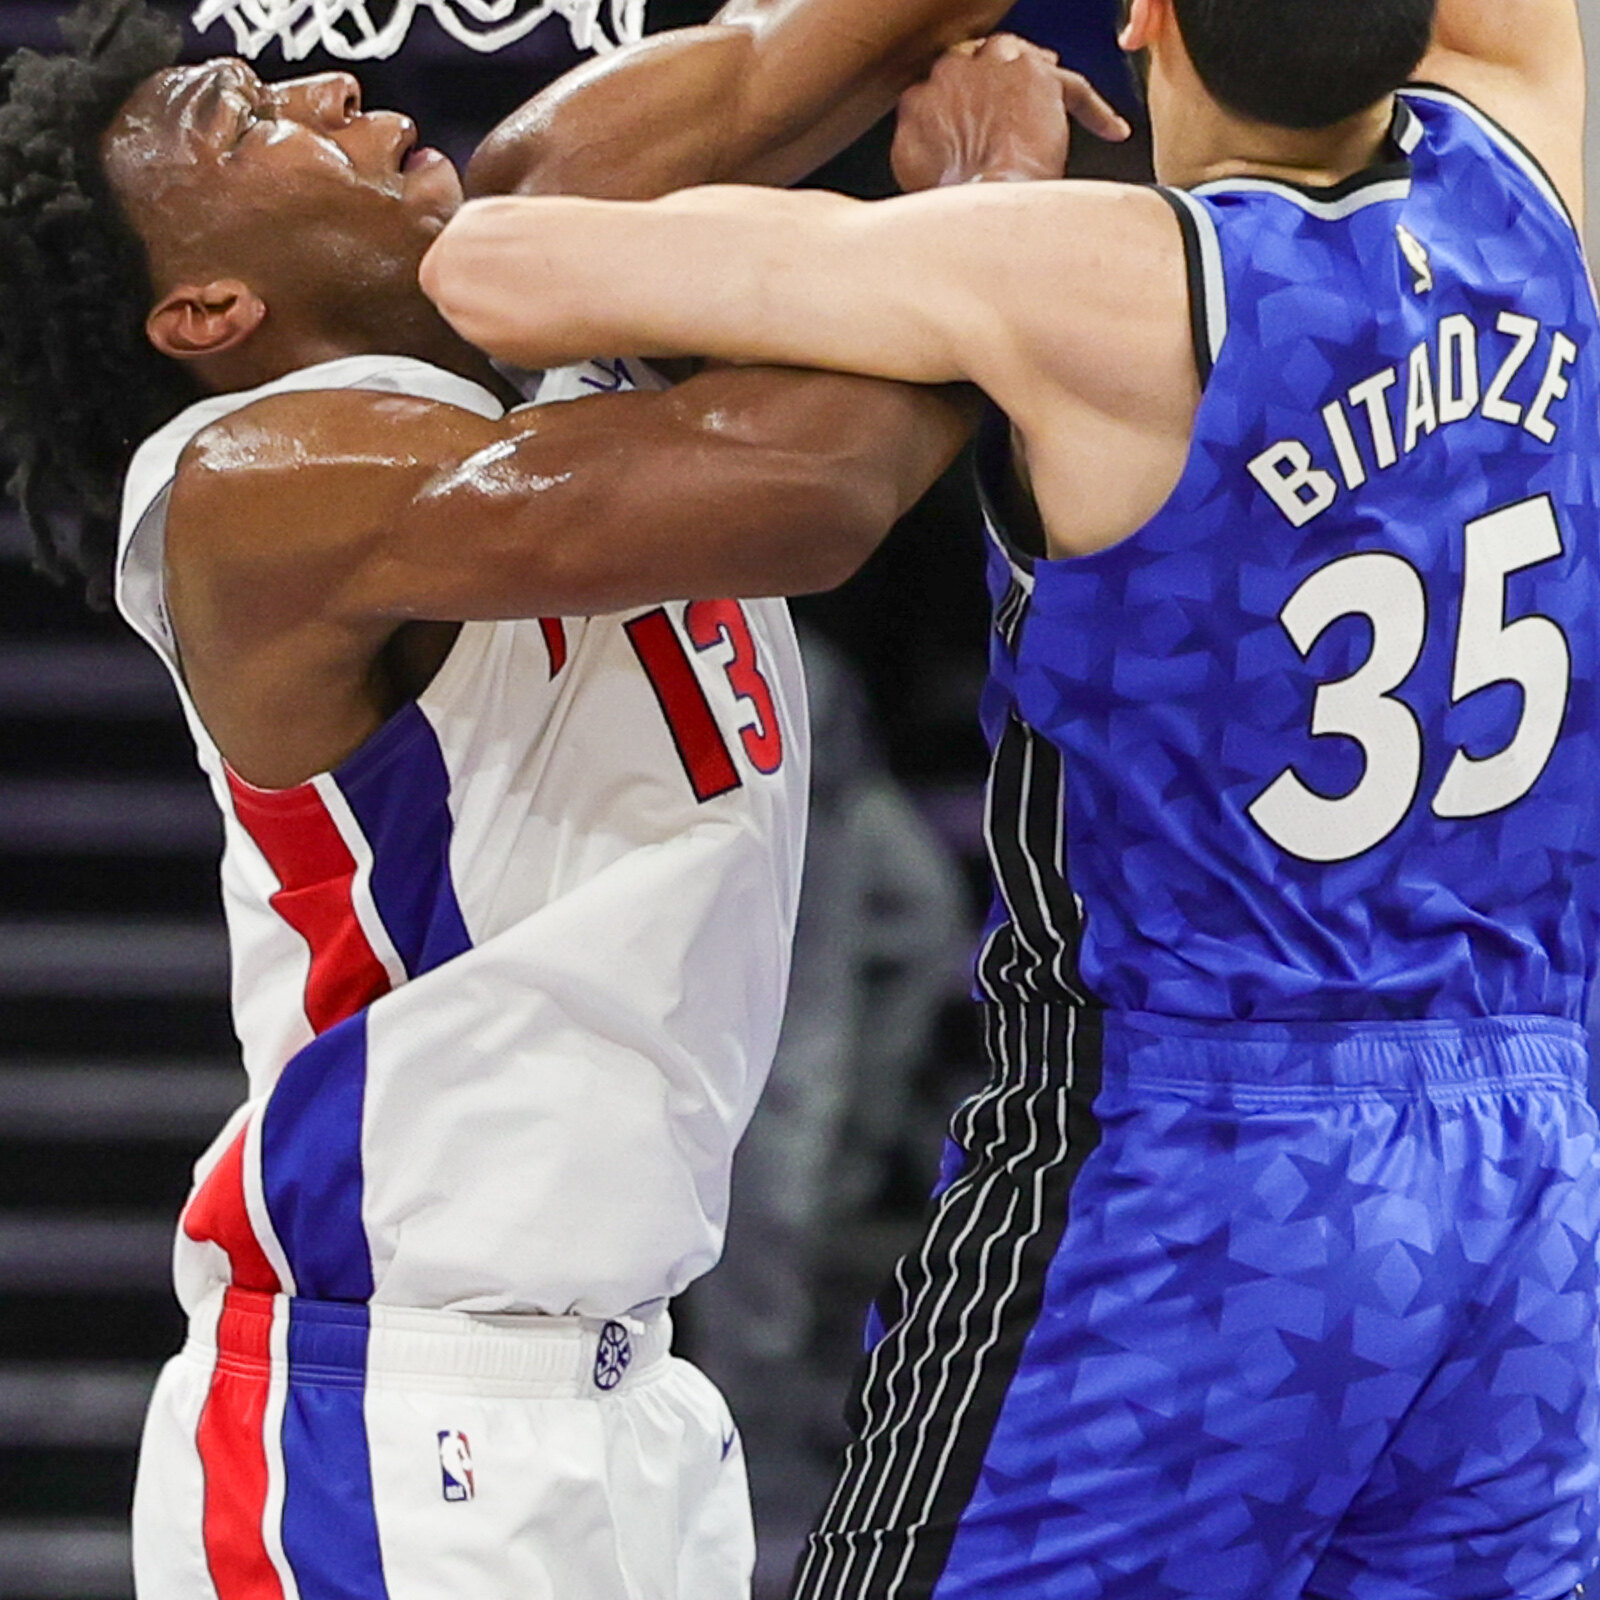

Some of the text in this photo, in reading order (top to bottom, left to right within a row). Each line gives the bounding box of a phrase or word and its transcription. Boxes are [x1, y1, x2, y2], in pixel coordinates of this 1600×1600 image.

[1246, 310, 1577, 529] BITADZE
[622, 597, 784, 805] 13
[1246, 492, 1572, 864] 35
